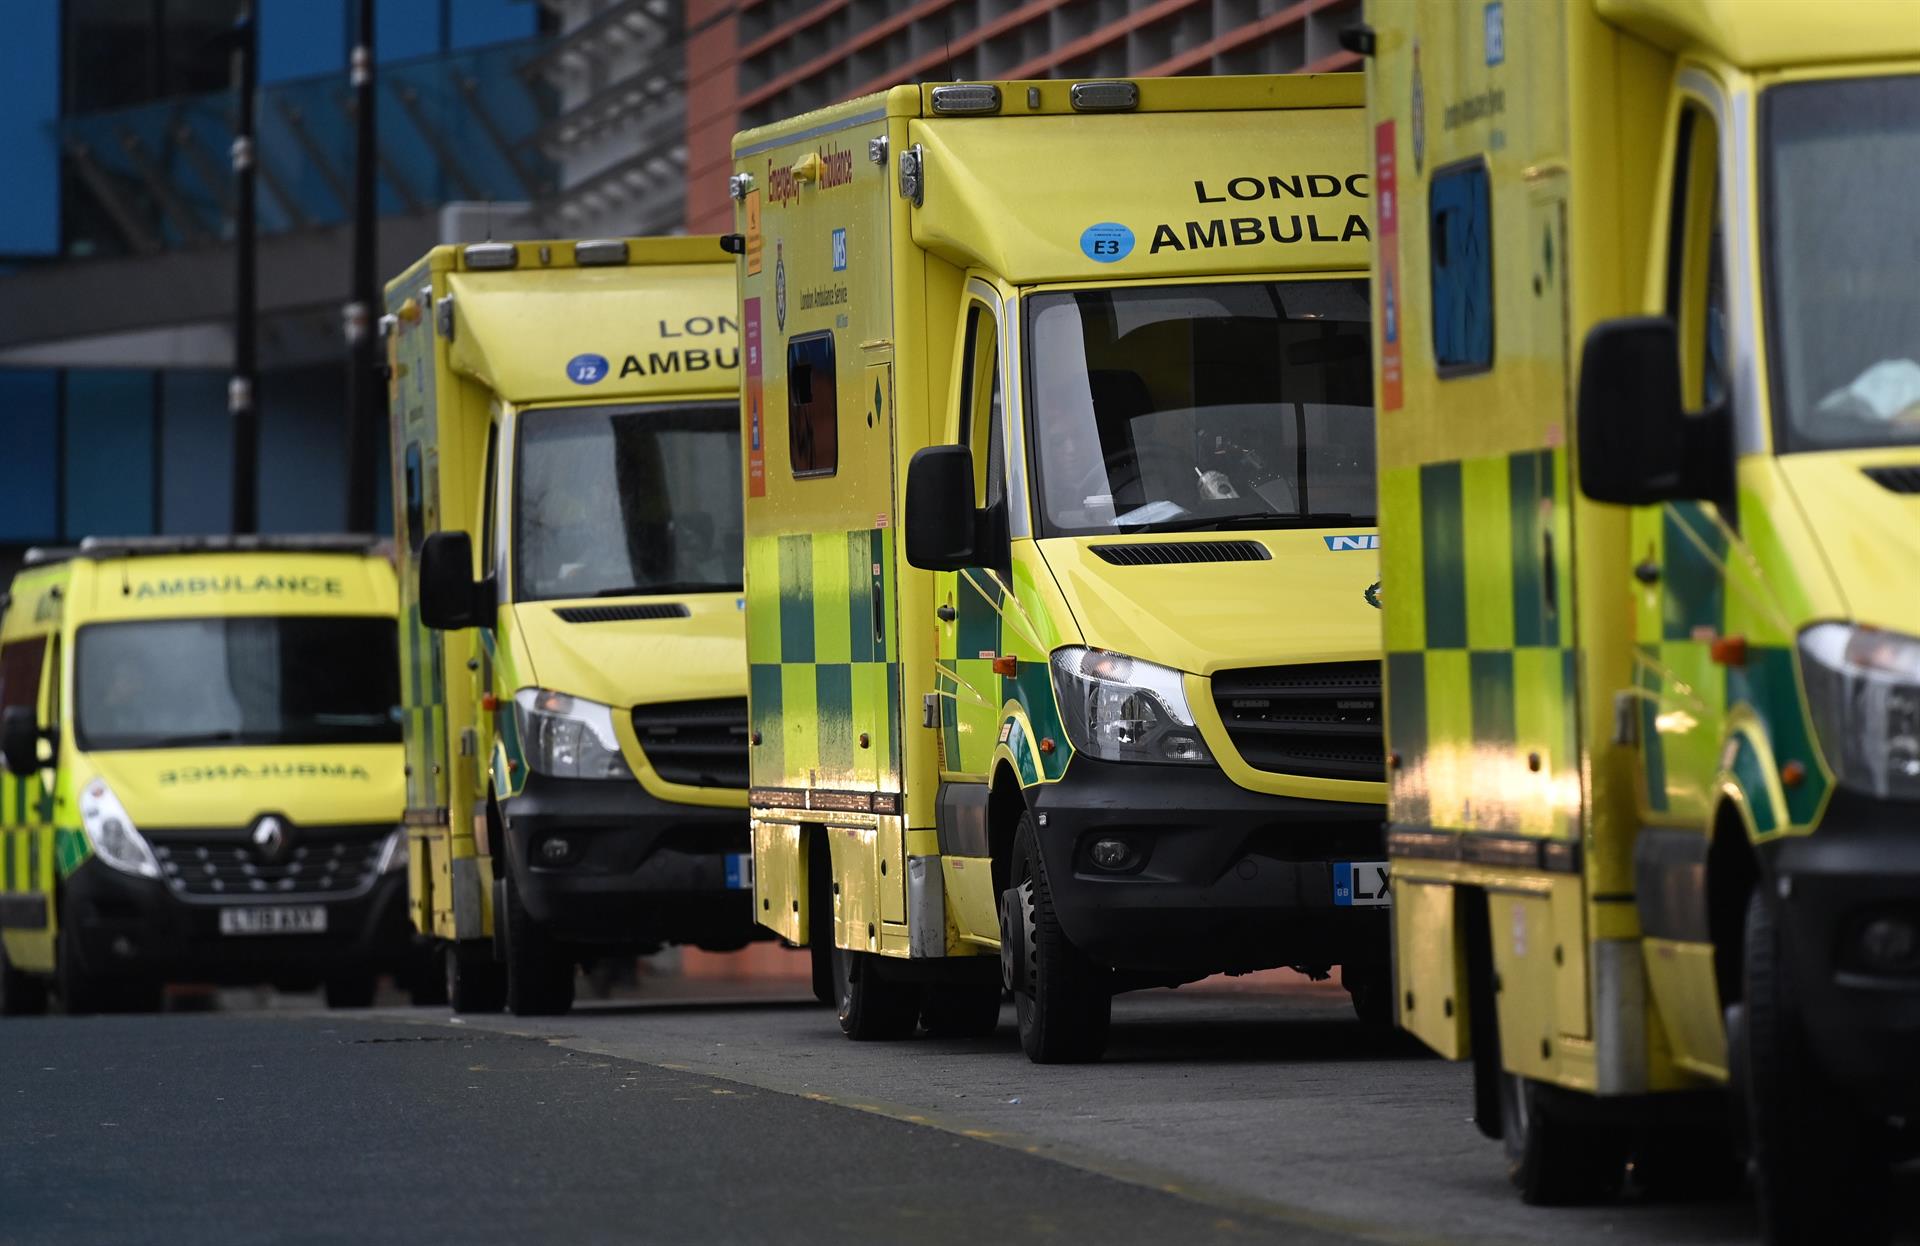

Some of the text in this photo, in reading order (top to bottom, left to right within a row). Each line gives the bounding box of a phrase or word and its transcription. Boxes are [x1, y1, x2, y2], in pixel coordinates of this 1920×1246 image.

[1094, 240, 1120, 255] E3
[1149, 213, 1371, 255] AMBULA
[833, 229, 846, 270] NHS
[576, 365, 598, 382] J2
[619, 347, 740, 380] AMBU
[136, 573, 344, 600] AMBULANCE
